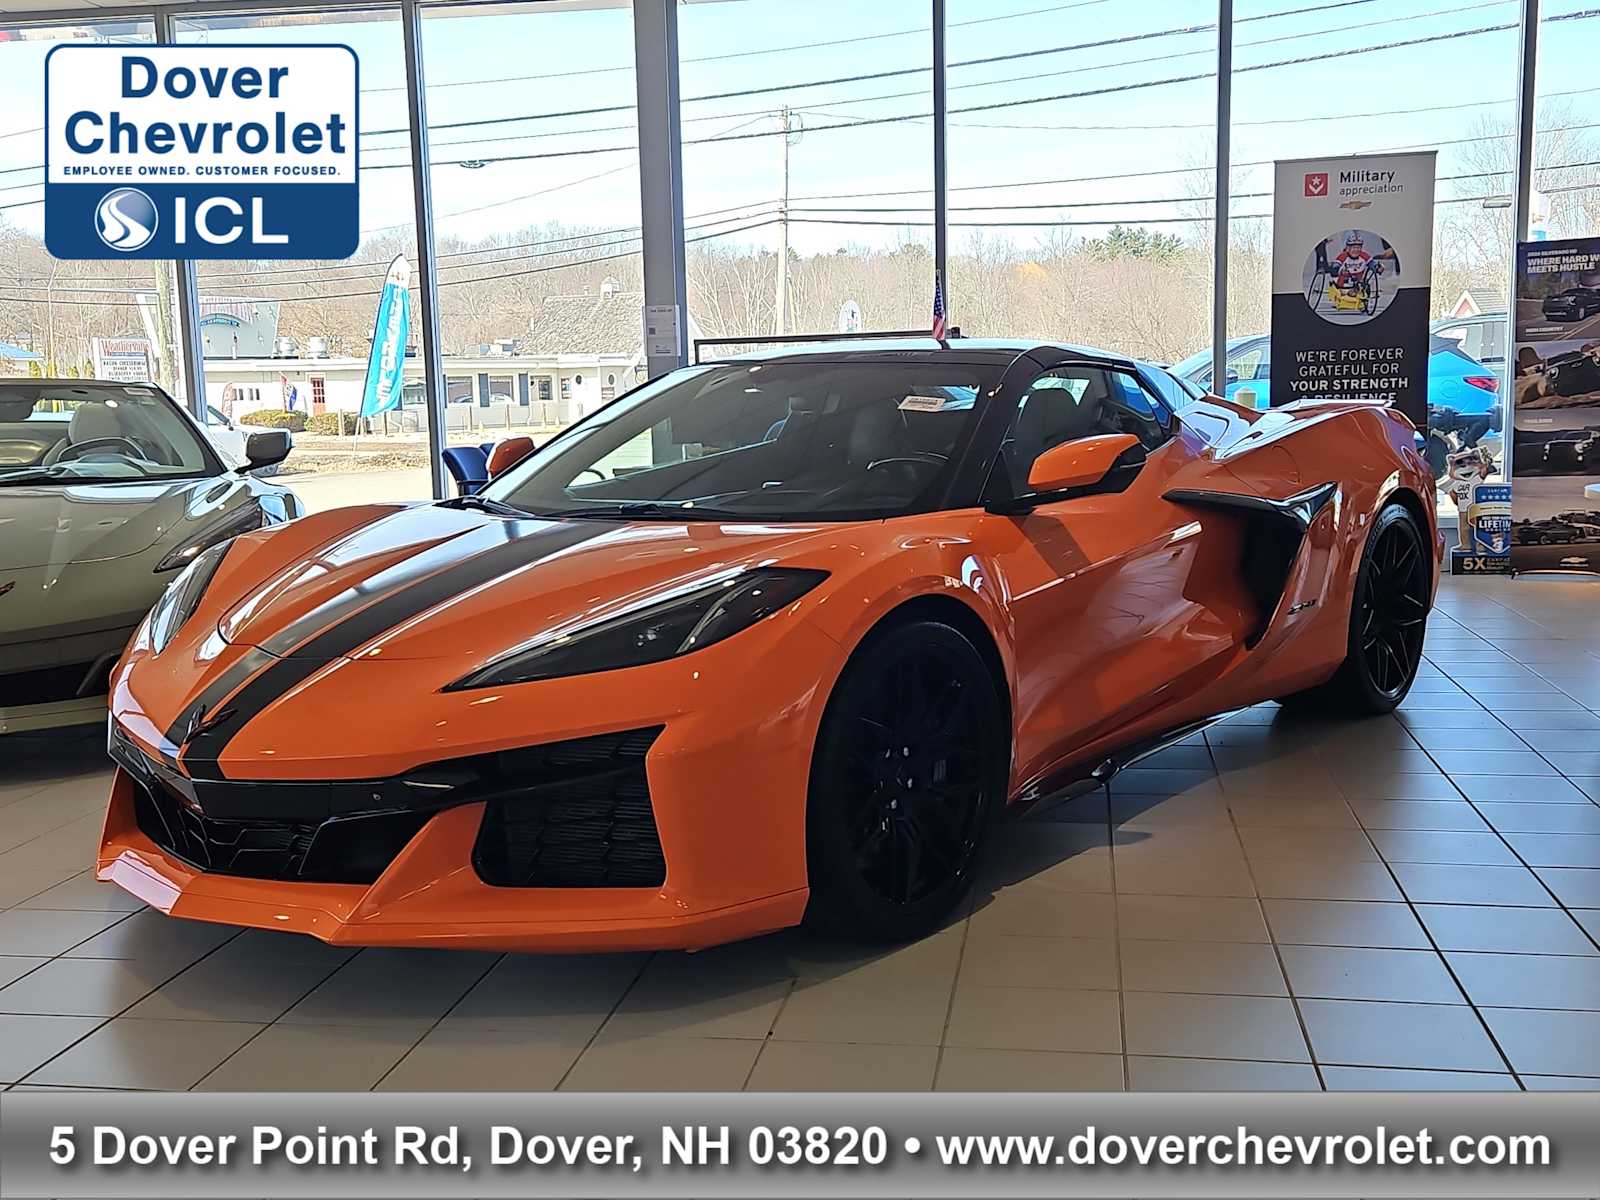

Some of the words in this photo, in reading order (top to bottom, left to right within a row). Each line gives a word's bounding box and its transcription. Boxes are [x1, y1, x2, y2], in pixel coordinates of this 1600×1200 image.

[1340, 170, 1395, 183] Military
[1340, 183, 1403, 196] appreciation
[1527, 256, 1561, 266] WHERE
[1562, 255, 1588, 264] HARD
[1527, 264, 1559, 274] MEETS
[1559, 262, 1596, 272] HUSTLE
[1295, 350, 1337, 362] WE'RE
[1341, 348, 1404, 361] FOREVER
[1299, 364, 1369, 377] GRATEFUL
[1373, 363, 1400, 374] FOR
[1290, 380, 1329, 391] YOUR
[1333, 377, 1408, 390] STRENGTH
[1457, 483, 1471, 492] CAR
[1479, 520, 1512, 529] LIFETIM
[1463, 557, 1486, 570] 5X
